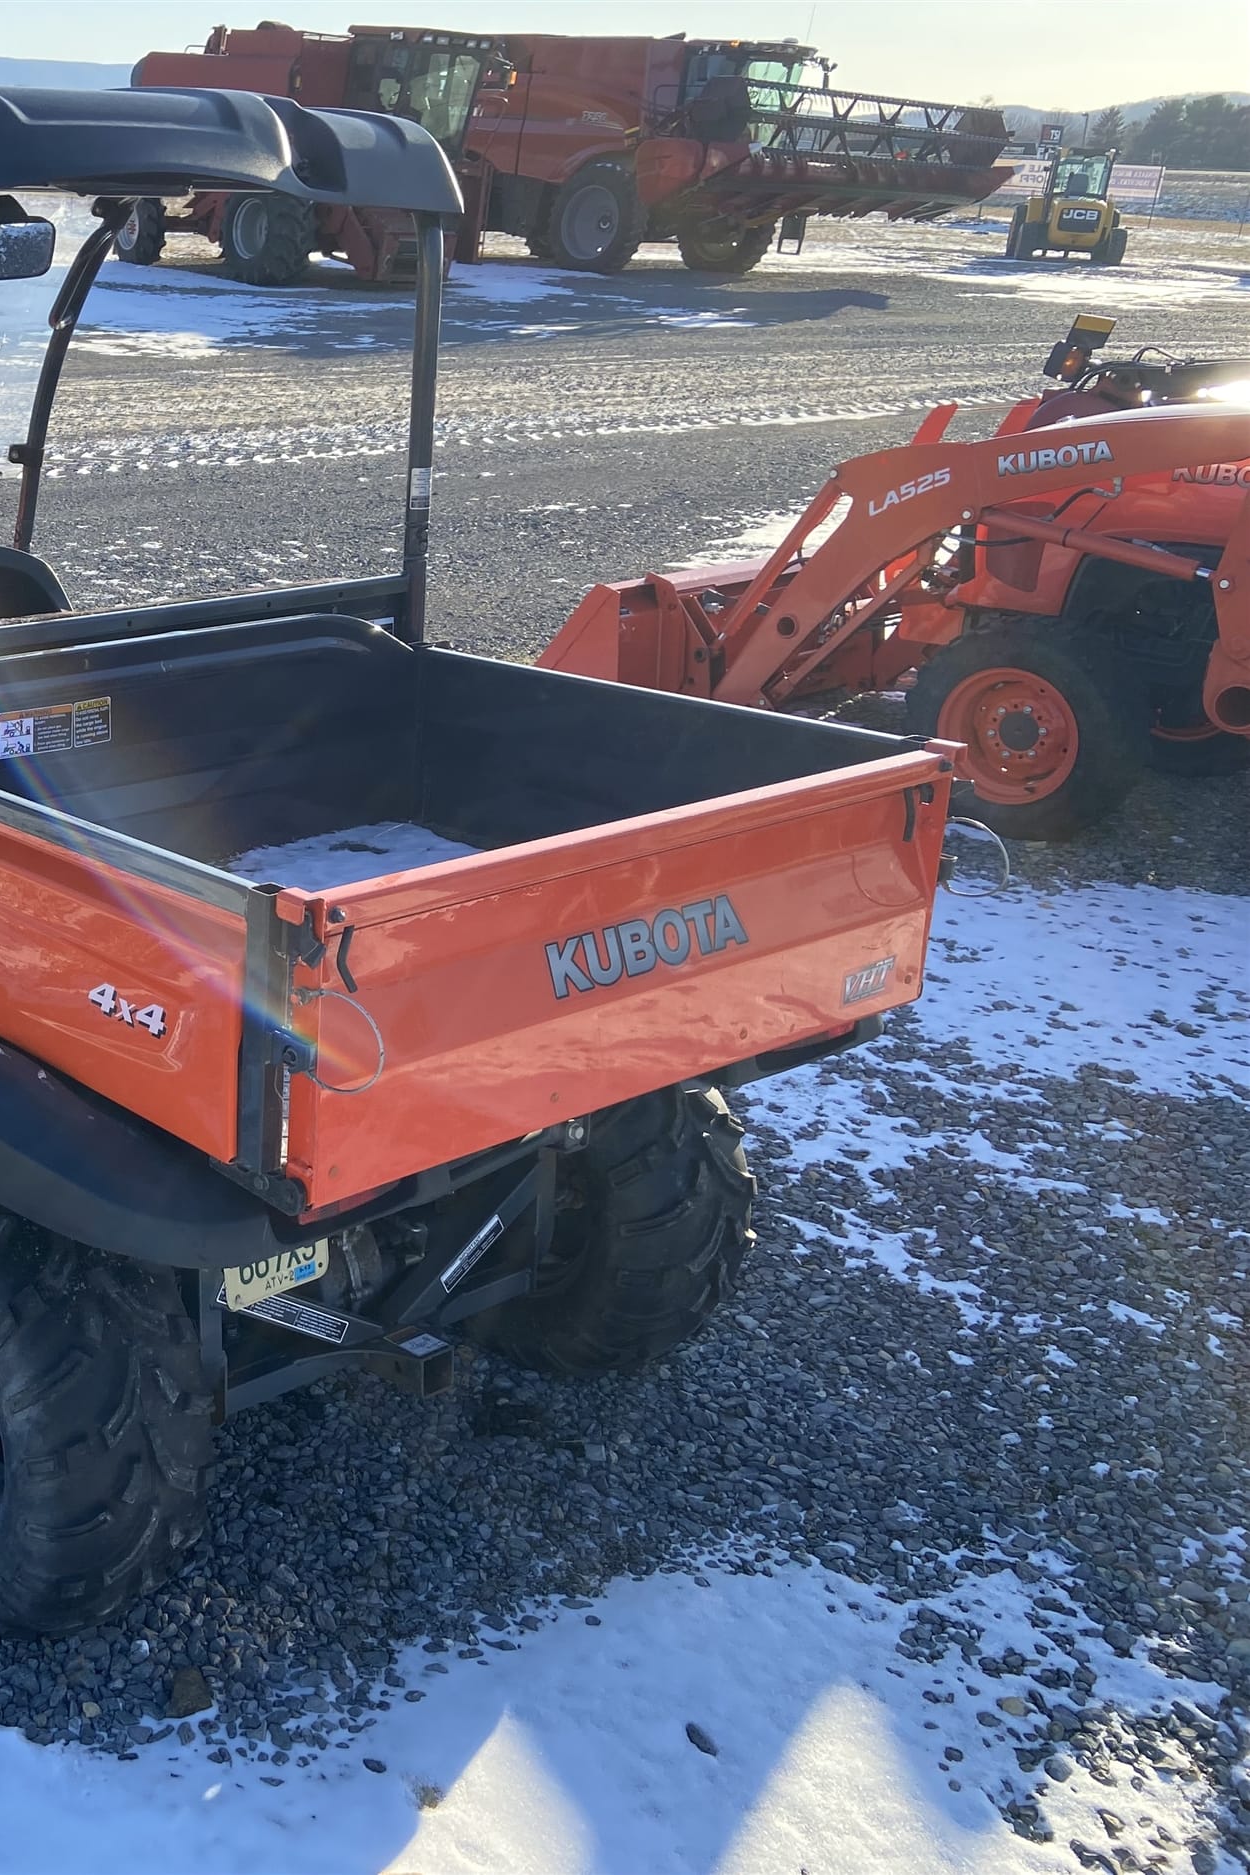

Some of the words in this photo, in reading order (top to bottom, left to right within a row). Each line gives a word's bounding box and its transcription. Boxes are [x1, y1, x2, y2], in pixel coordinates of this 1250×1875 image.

[1062, 209, 1098, 220] JCB
[997, 440, 1115, 478] KUBOTA
[868, 467, 950, 517] LA525
[545, 894, 749, 1000] KUBOTA
[87, 983, 167, 1039] 4x4
[264, 1270, 295, 1291] ATV-2
